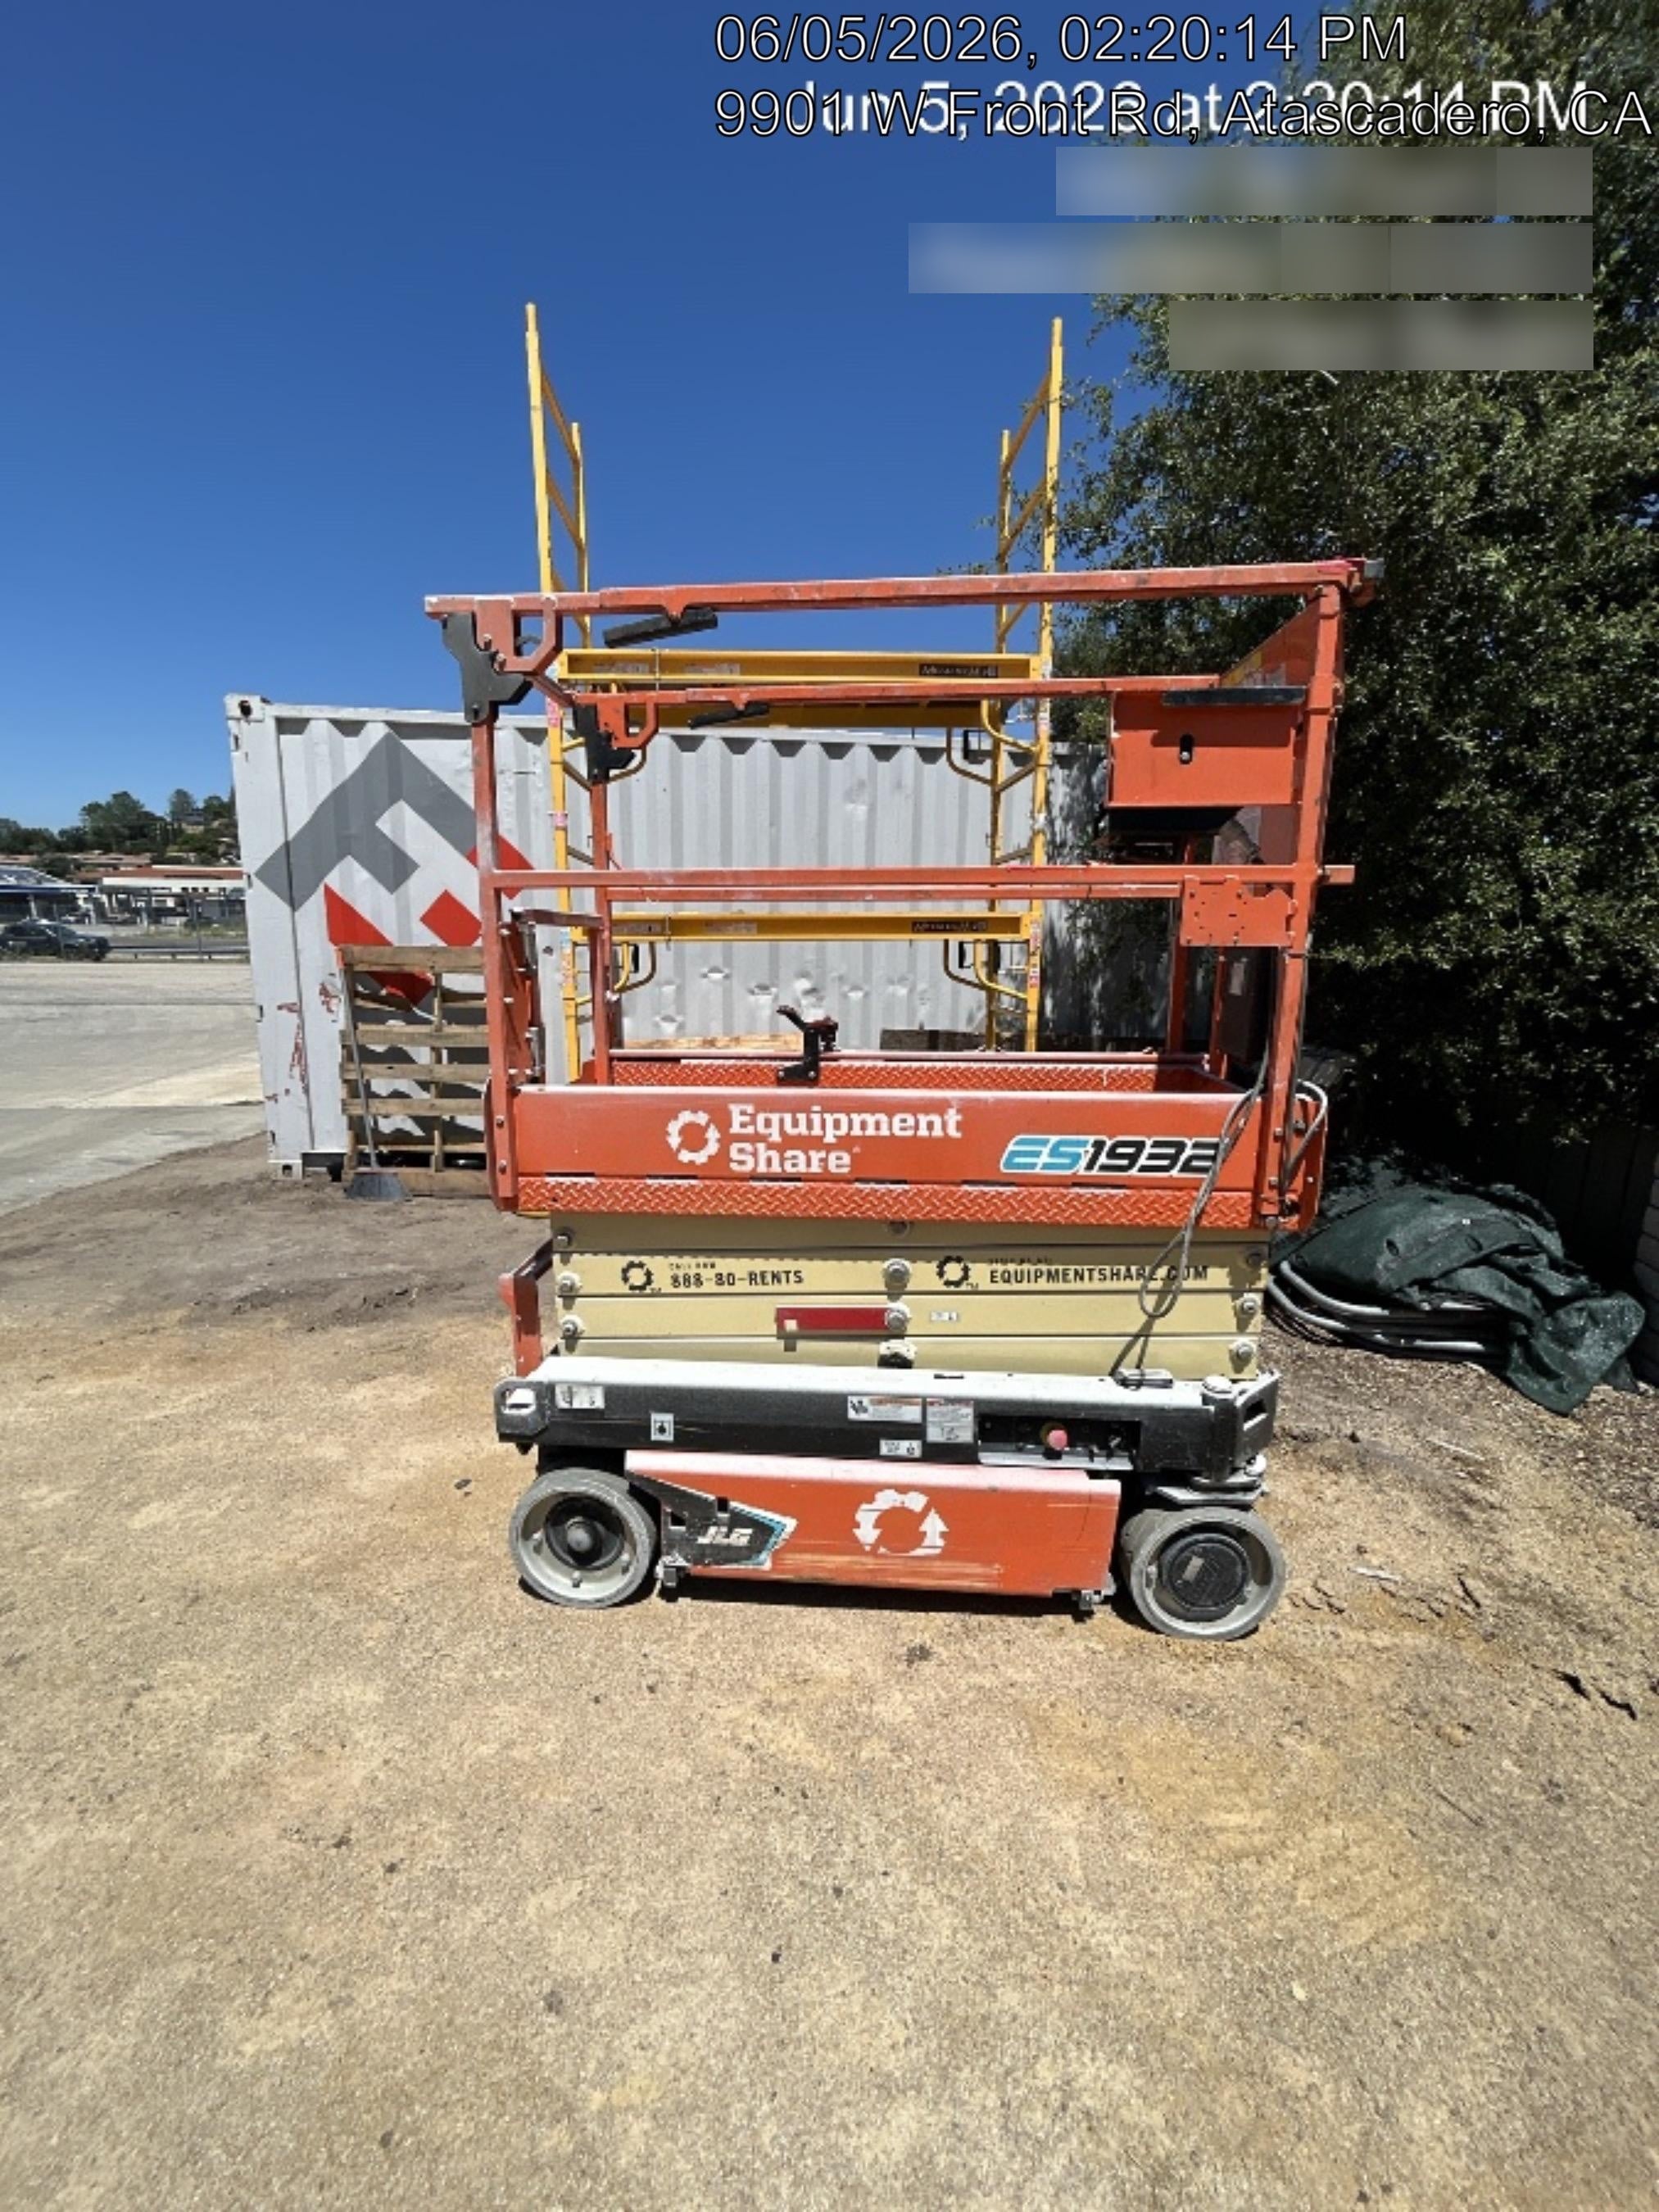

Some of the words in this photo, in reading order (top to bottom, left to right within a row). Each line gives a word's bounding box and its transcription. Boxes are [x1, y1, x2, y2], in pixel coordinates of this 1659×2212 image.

[728, 1103, 963, 1144] Equipment
[1000, 1135, 1222, 1177] ES1932
[670, 1271, 805, 1289] 888-80-RENTS
[696, 1525, 753, 1547] JLG
